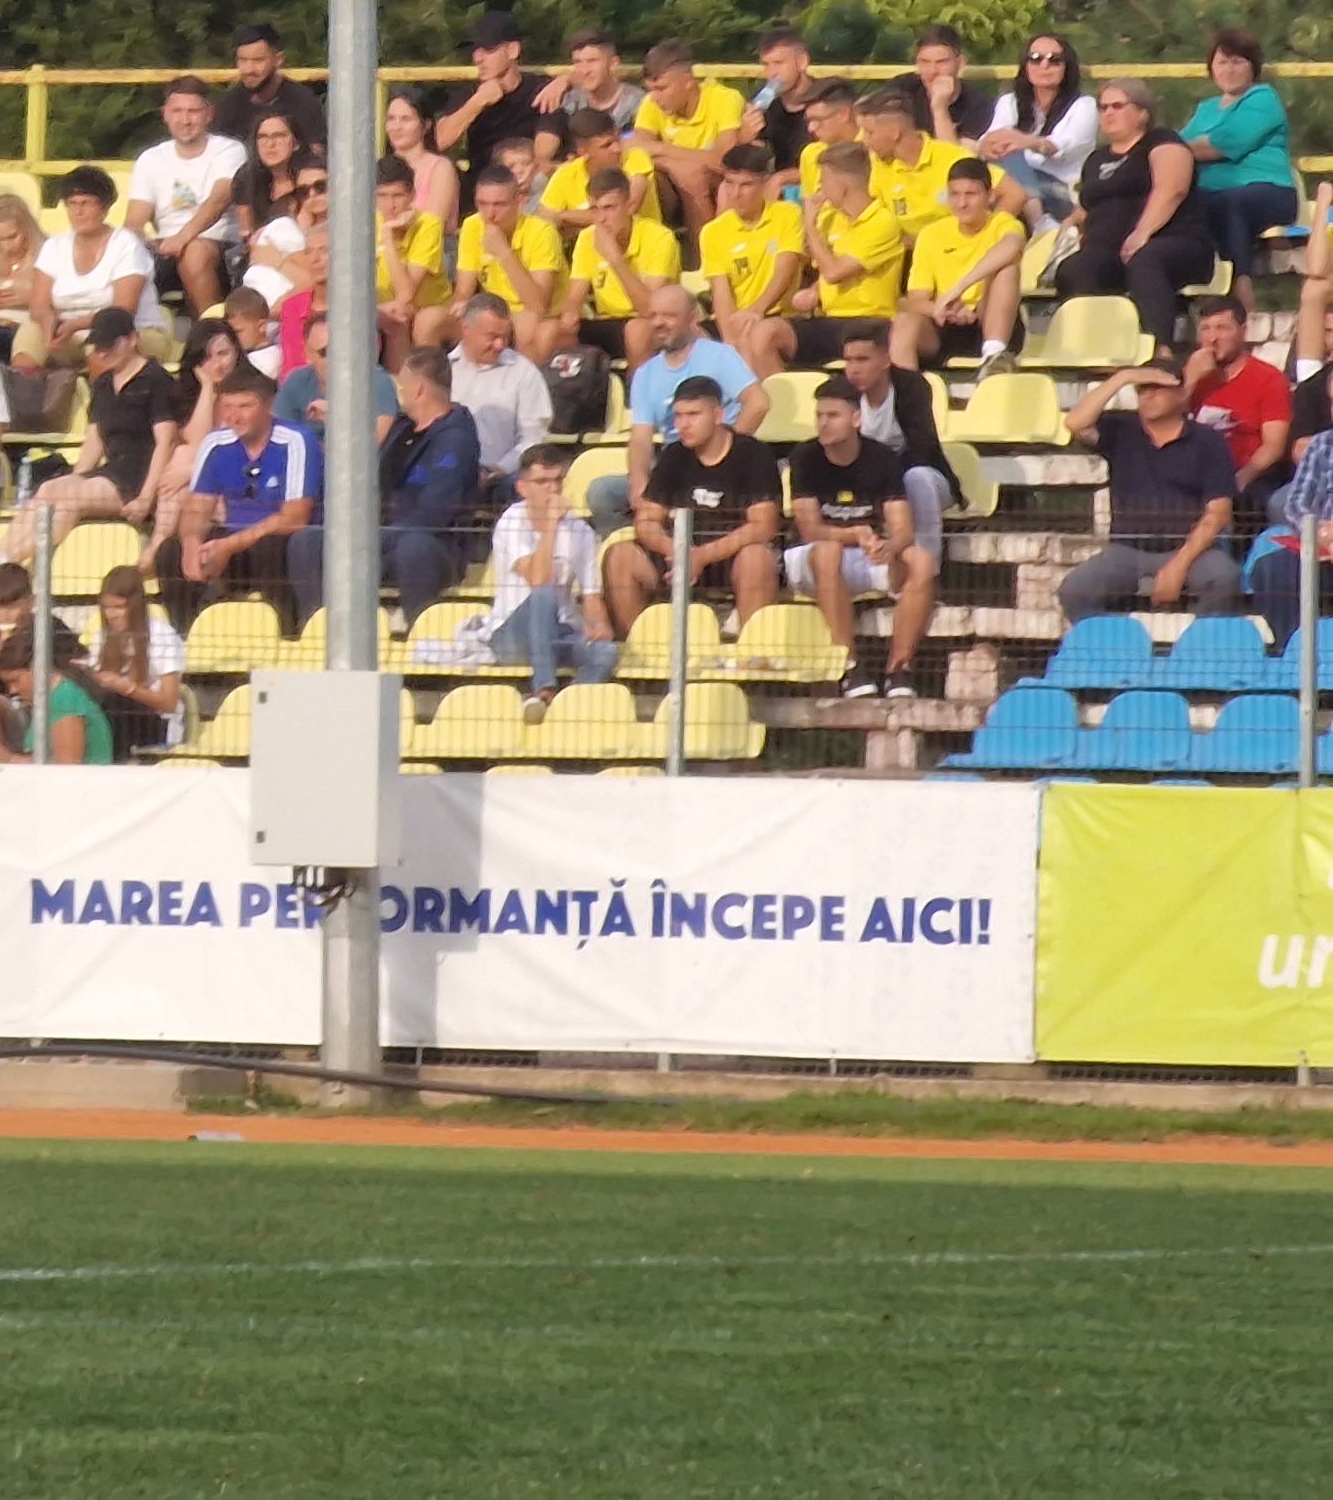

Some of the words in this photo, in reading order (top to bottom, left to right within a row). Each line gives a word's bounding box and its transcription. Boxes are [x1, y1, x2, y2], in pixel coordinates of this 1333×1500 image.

[30, 877, 222, 927] MAREA
[239, 877, 637, 949] PERORMANȚĂ
[650, 878, 846, 942] ÎNCEPE
[859, 895, 993, 946] AICI!
